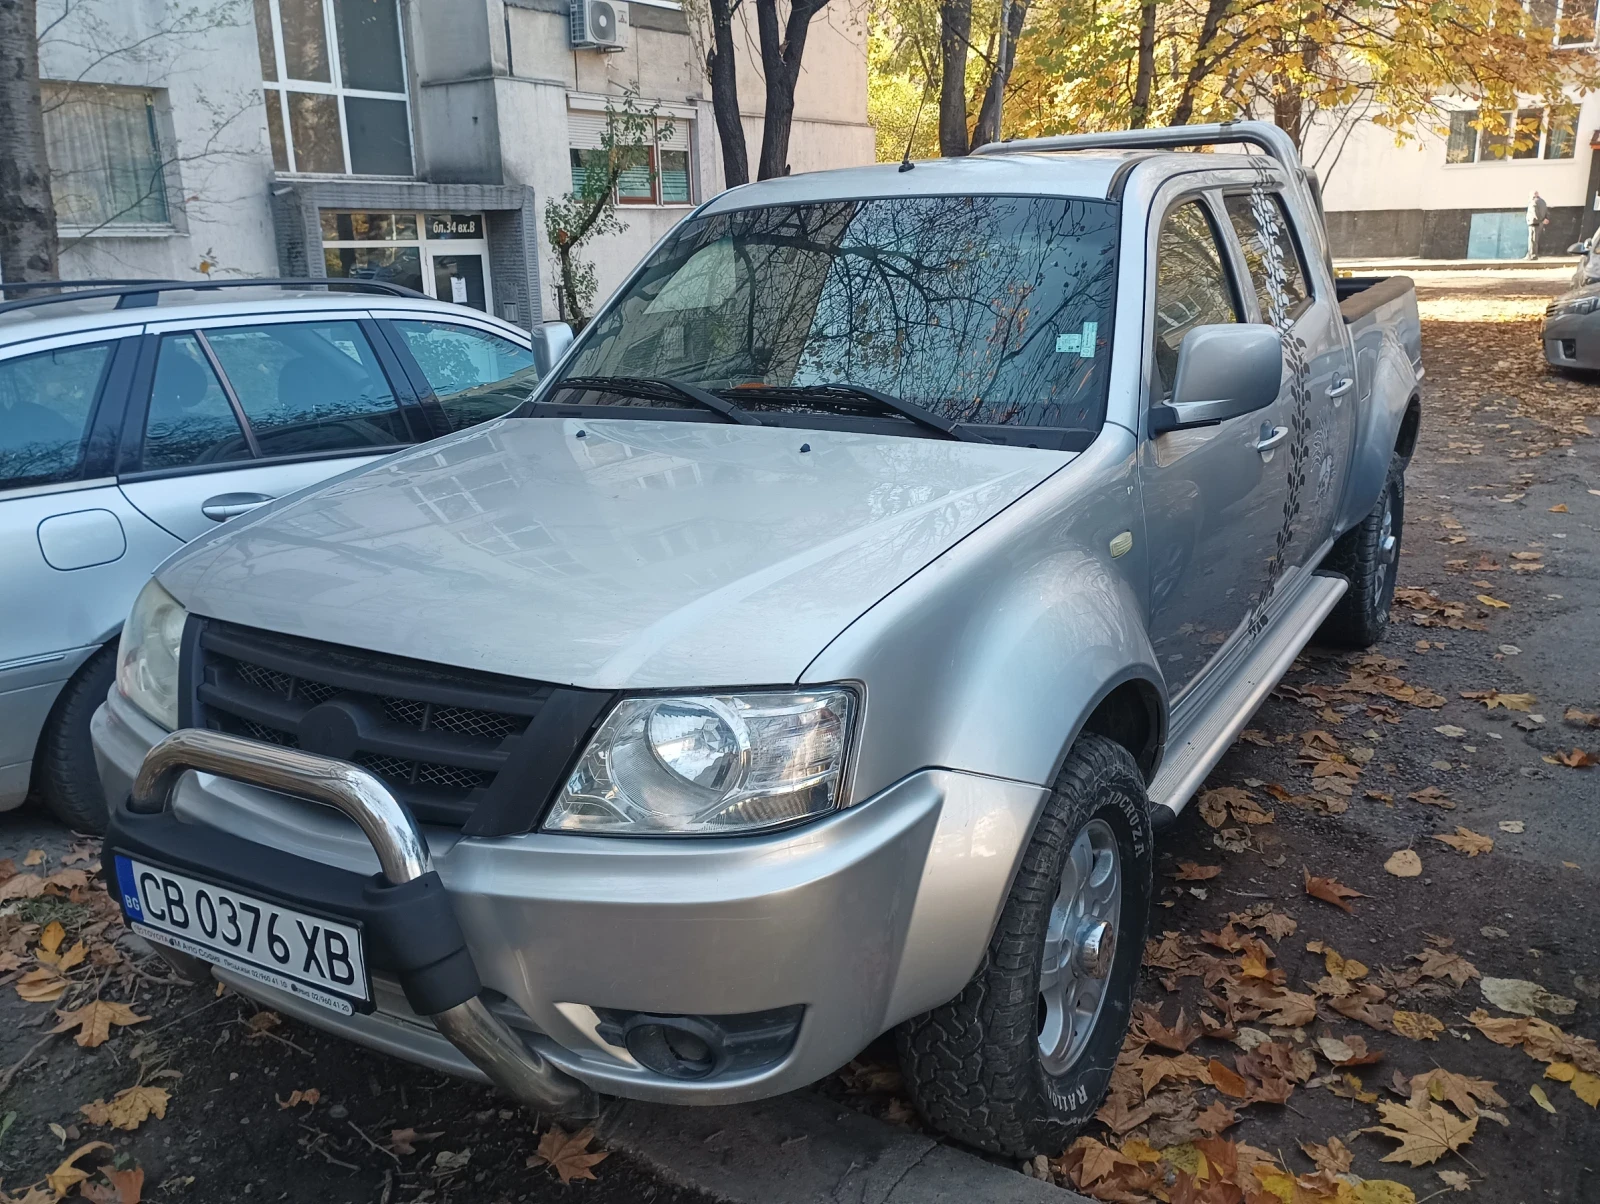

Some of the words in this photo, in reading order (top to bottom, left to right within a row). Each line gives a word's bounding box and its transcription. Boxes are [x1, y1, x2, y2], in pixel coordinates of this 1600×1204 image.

[433, 221, 457, 233] бл.34
[457, 221, 476, 233] вх.В
[124, 894, 140, 911] BG
[140, 871, 190, 930] CB
[195, 889, 291, 965] 0376
[295, 919, 355, 986] XB
